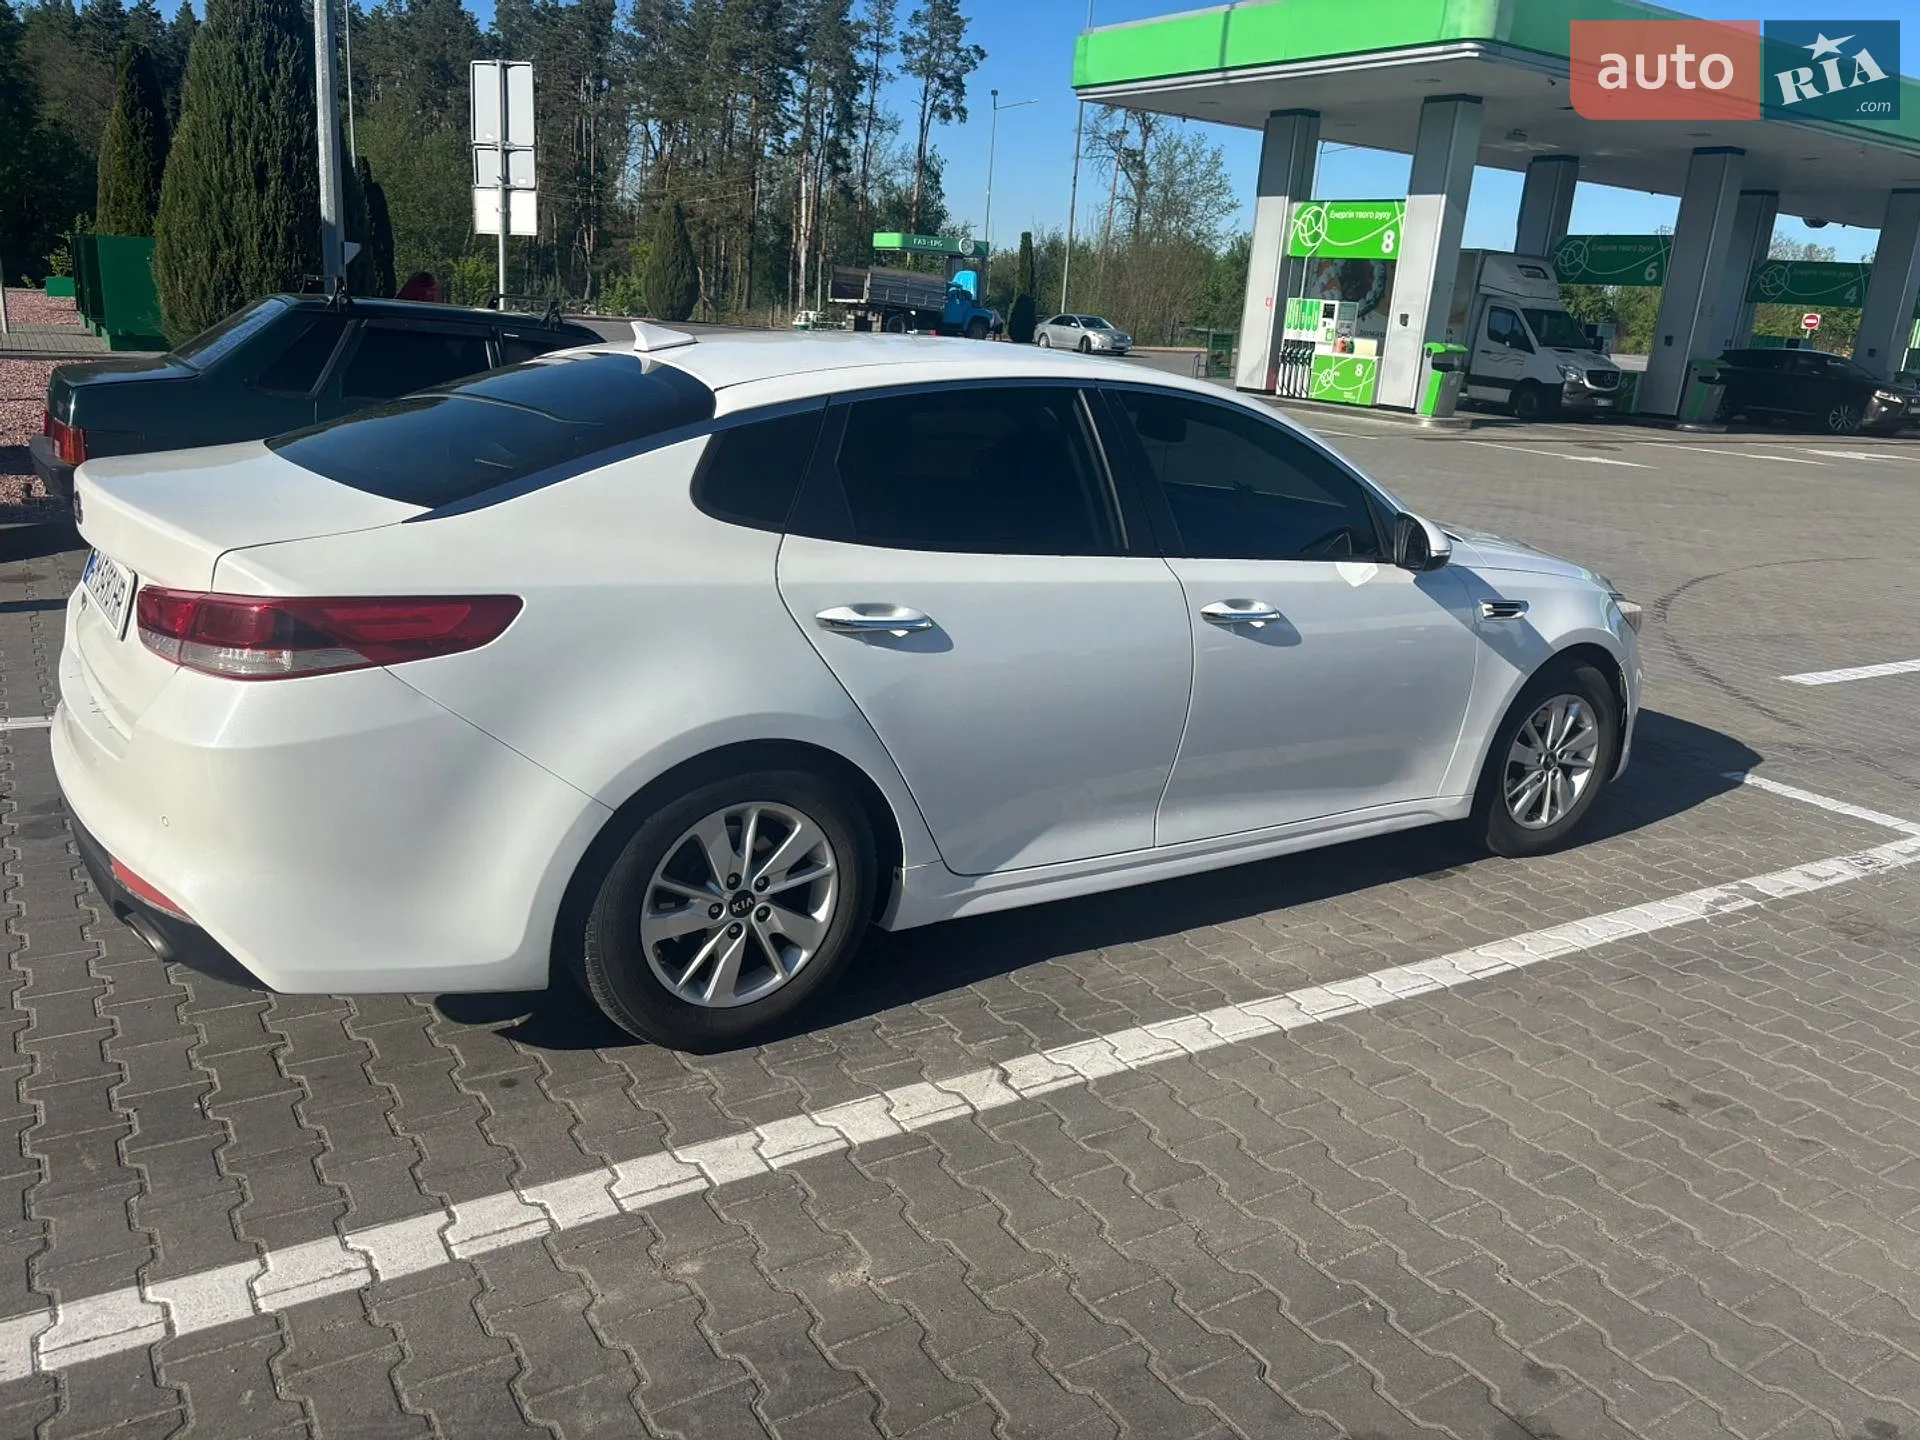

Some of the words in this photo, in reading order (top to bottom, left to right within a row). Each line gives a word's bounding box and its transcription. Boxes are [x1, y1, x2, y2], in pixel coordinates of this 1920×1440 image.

[1381, 229, 1395, 254] 8
[1644, 261, 1658, 281] 6
[1844, 285, 1857, 303] 4
[1354, 363, 1364, 377] 8
[731, 897, 754, 913] KIA
